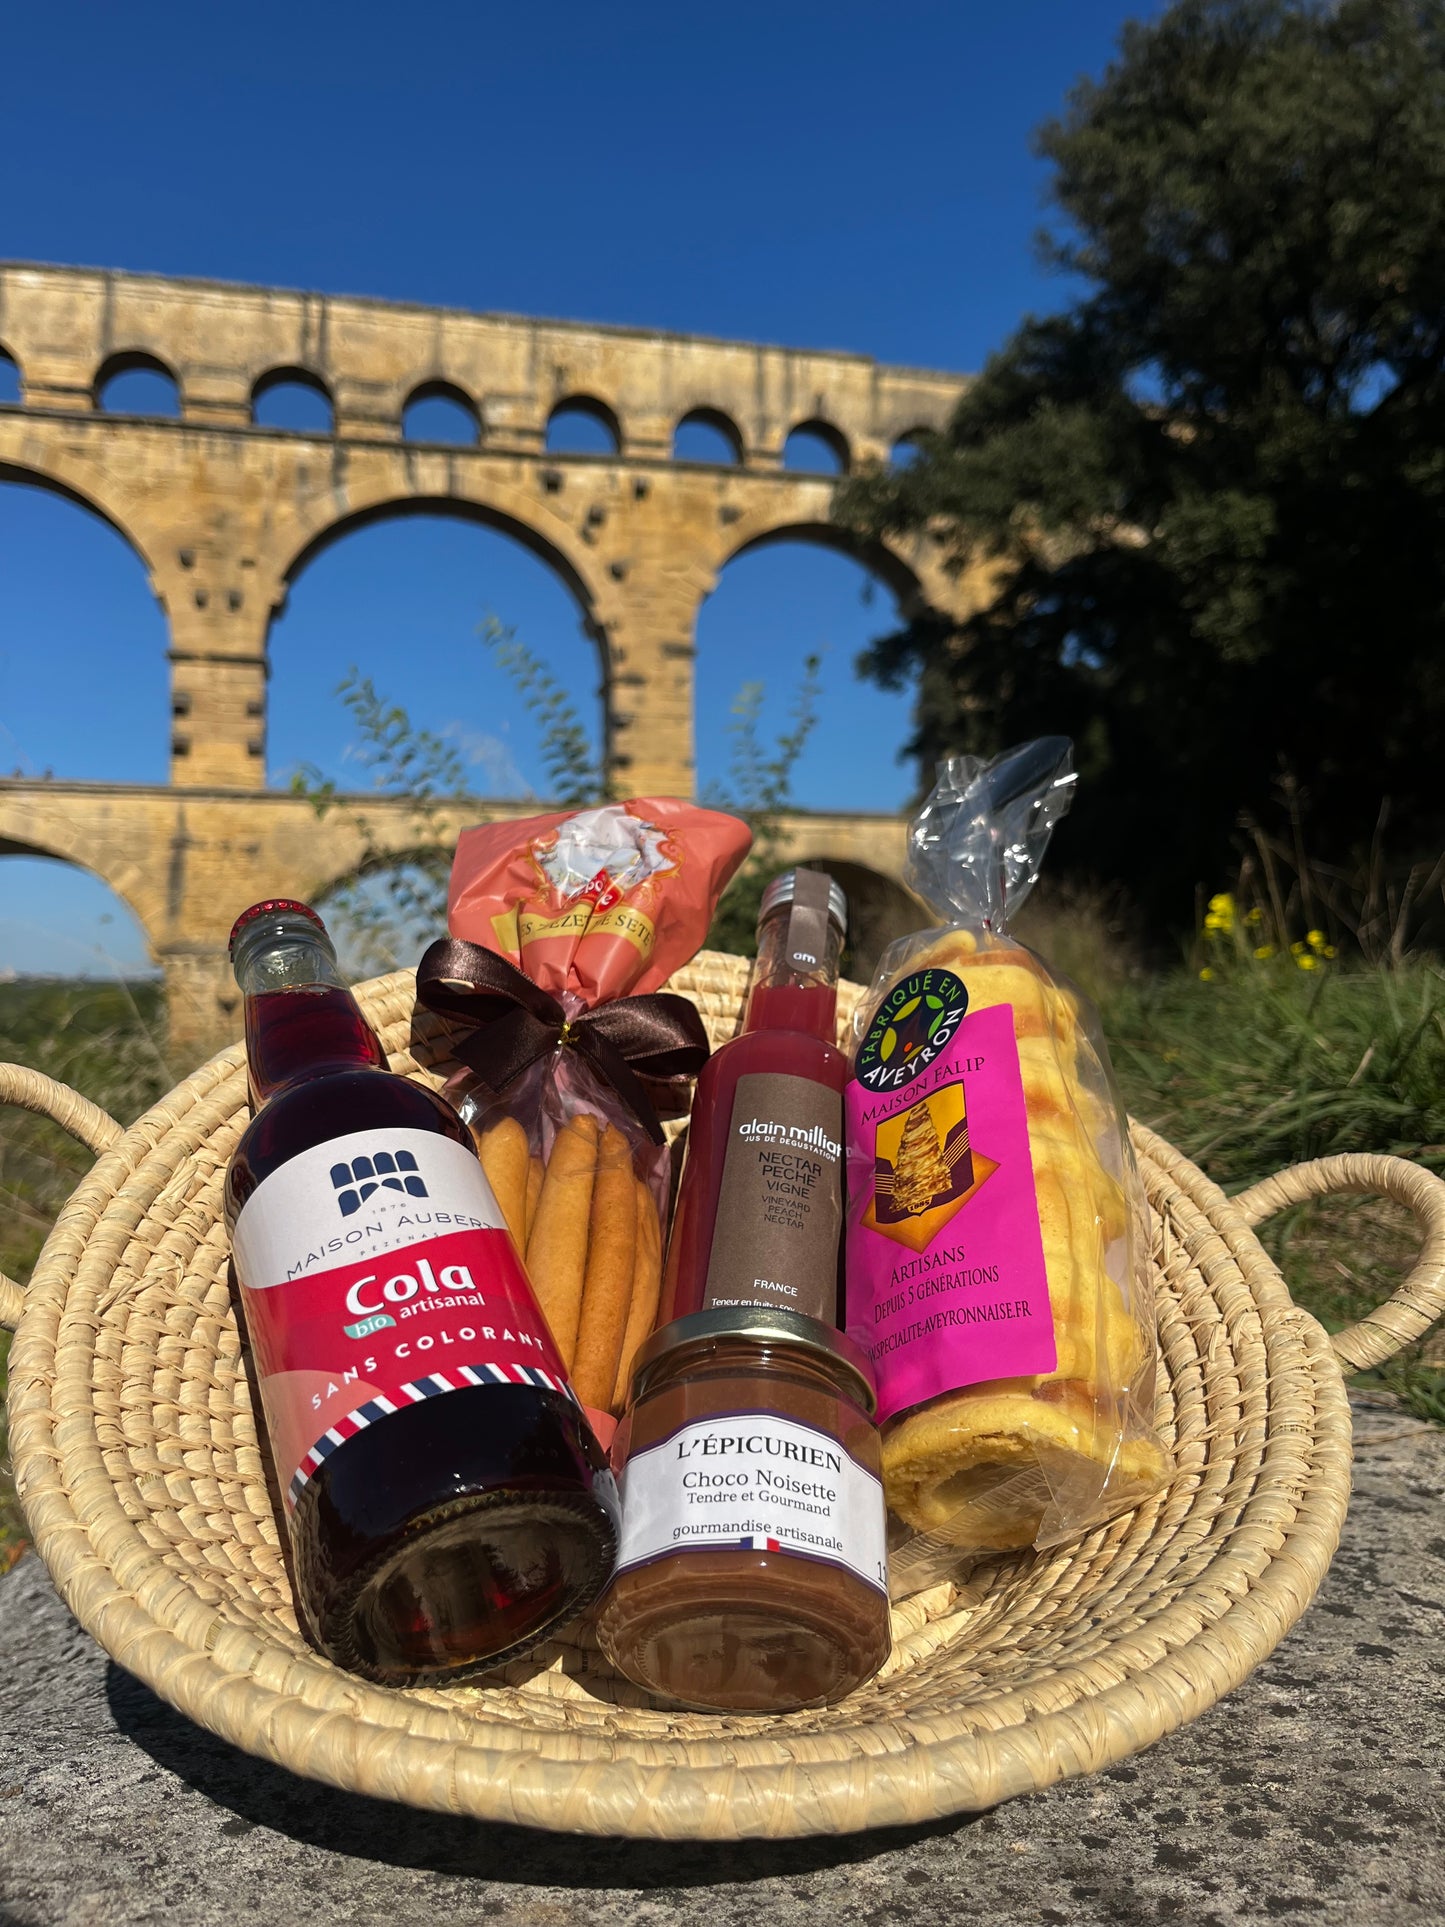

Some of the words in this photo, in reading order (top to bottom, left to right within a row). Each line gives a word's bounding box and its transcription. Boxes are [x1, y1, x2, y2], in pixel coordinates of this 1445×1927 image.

[793, 952, 816, 965] am
[861, 970, 933, 1065] FABRIQUÉ
[938, 977, 961, 1003] EN
[863, 1007, 965, 1088] AVEYRON
[860, 1078, 928, 1127] MAISON
[933, 1056, 985, 1085] FALIP
[739, 1118, 787, 1137] alain
[789, 1125, 843, 1158] milliat
[744, 1135, 761, 1143] JUS
[764, 1135, 776, 1143] DE
[779, 1137, 836, 1163] DEGUSTATION
[758, 1151, 822, 1177] NECTAR
[762, 1164, 817, 1189] PECHE
[766, 1179, 810, 1200] VIGNE
[761, 1195, 811, 1213] VINEYARD
[767, 1204, 802, 1220] PEACH
[764, 1214, 805, 1231] NECTAR
[286, 1221, 383, 1281] MAISON
[889, 1245, 966, 1288] ARTISANS
[345, 1258, 477, 1316] Cola
[753, 1279, 798, 1297] FRANCE
[874, 1291, 906, 1325] DEPUIS
[907, 1286, 914, 1305] 5
[916, 1265, 1000, 1300] GÉNÉRATIONS
[400, 1292, 486, 1319] artisanal
[711, 1298, 740, 1306] Teneur
[354, 1316, 389, 1338] bio
[311, 1356, 378, 1410] SANS
[394, 1326, 544, 1358] COLORANT
[682, 1471, 749, 1489] Choco
[755, 1469, 837, 1502] Noisette
[687, 1491, 737, 1504] Tendre
[741, 1491, 754, 1502] et
[758, 1490, 831, 1517] Gourmand
[672, 1519, 772, 1539] gourmandise
[775, 1524, 843, 1552] artisanale
